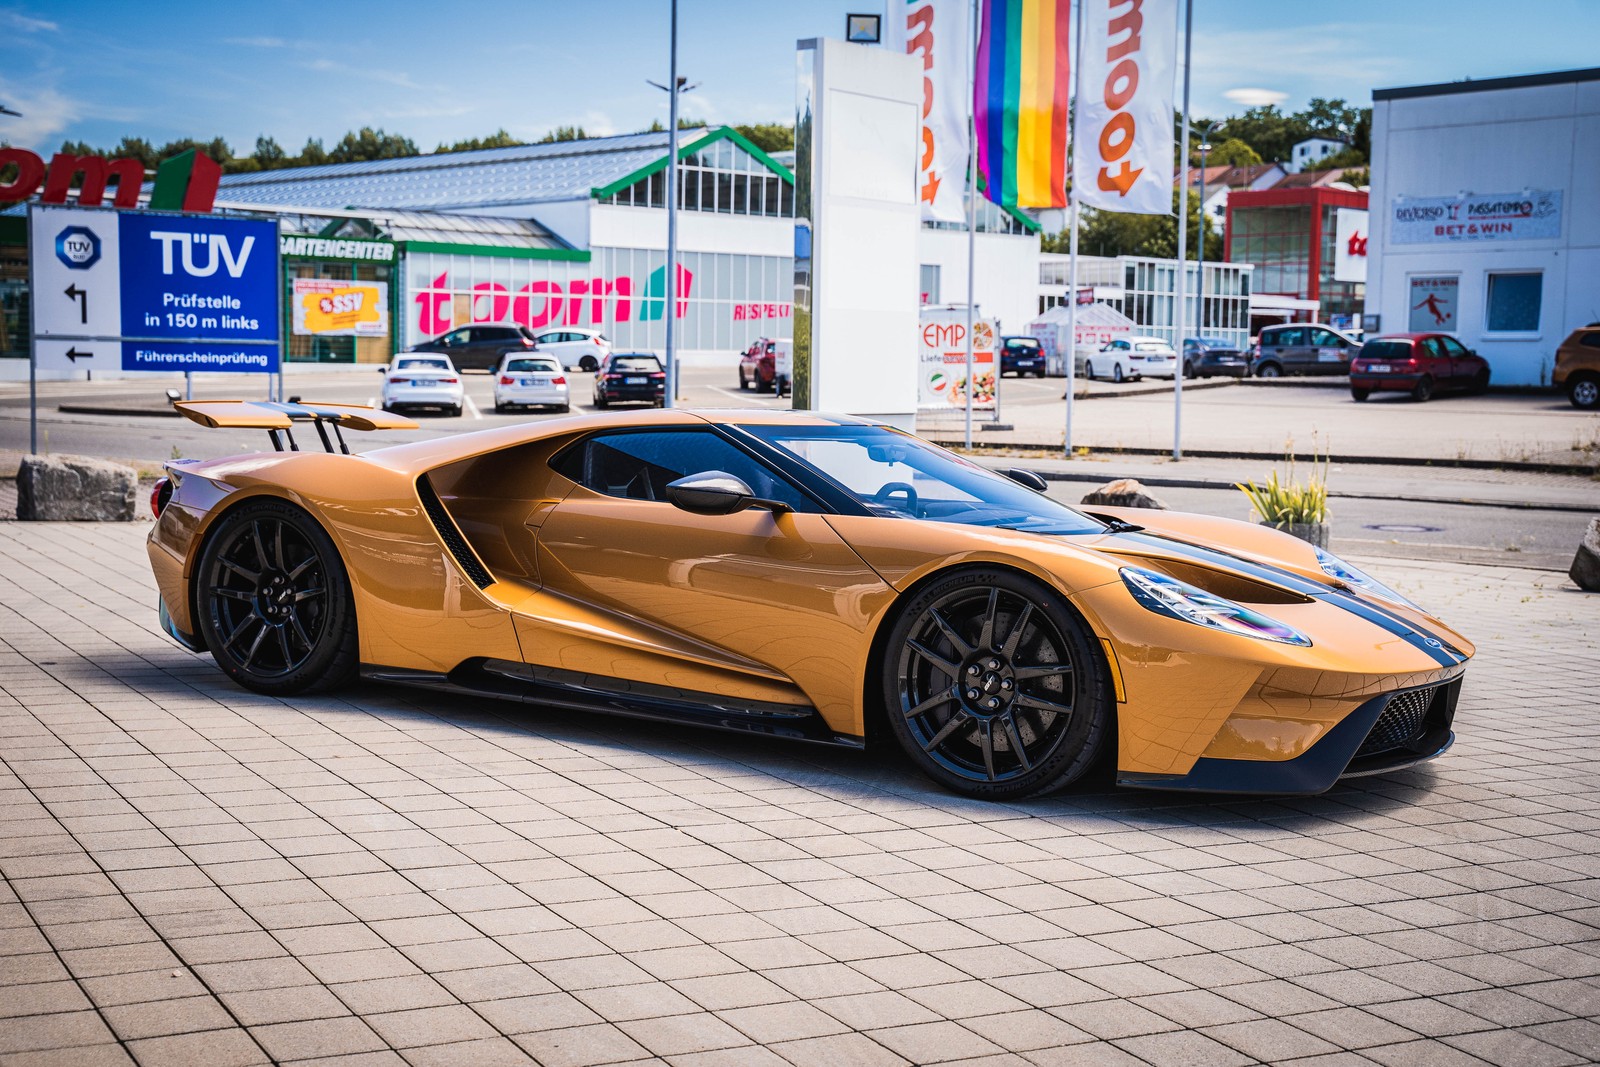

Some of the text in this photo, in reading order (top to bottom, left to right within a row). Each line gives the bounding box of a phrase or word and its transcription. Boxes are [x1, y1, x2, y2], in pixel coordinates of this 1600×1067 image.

[1097, 0, 1144, 198] toom
[150, 230, 256, 278] TÜV
[280, 236, 394, 261] GARTENCENTER
[163, 292, 241, 310] Prüfstelle
[415, 271, 632, 336] toom
[145, 312, 259, 330] in 150 m links
[136, 350, 268, 367] Führerscheinprüfung
[932, 574, 976, 596] MICHELIN
